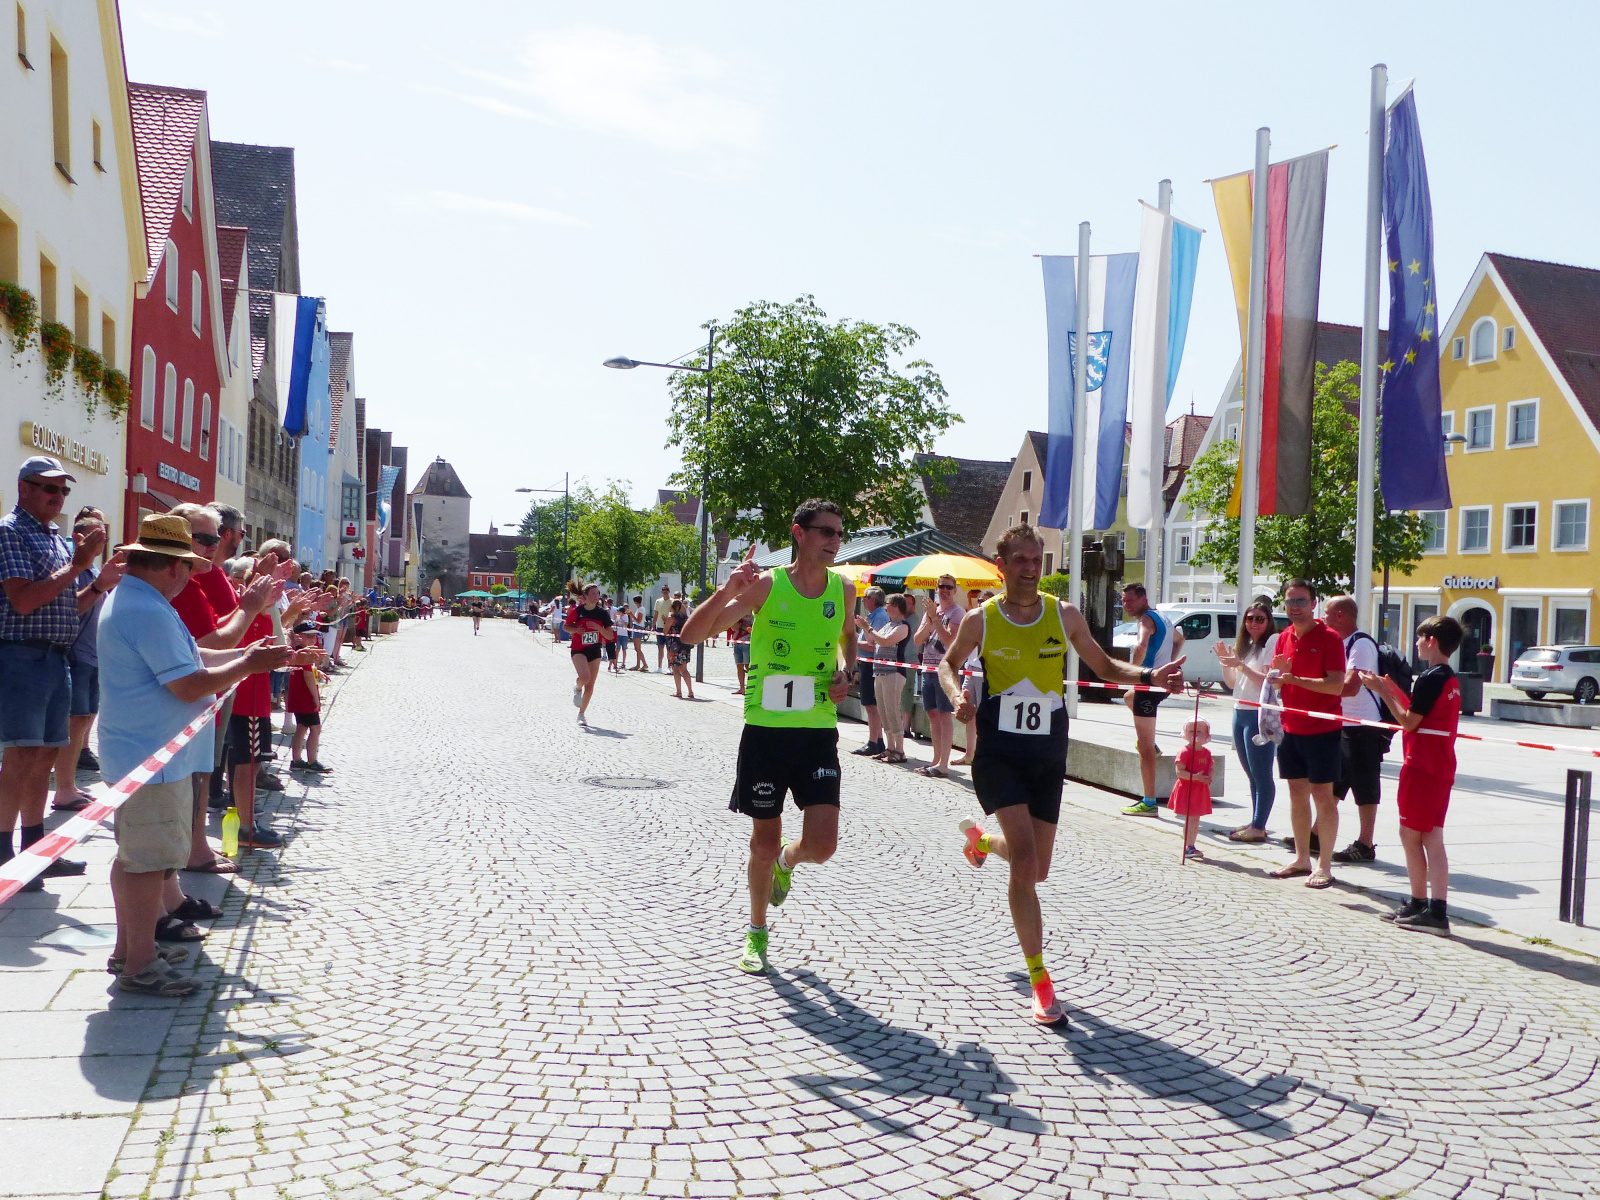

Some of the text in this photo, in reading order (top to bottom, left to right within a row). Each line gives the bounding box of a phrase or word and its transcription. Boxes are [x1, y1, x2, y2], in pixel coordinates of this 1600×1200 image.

[32, 421, 84, 464] GOLDSCHMIEDE
[1443, 575, 1498, 589] Gutbrod
[583, 632, 598, 643] 250
[784, 680, 794, 708] 1
[1014, 701, 1041, 731] 18
